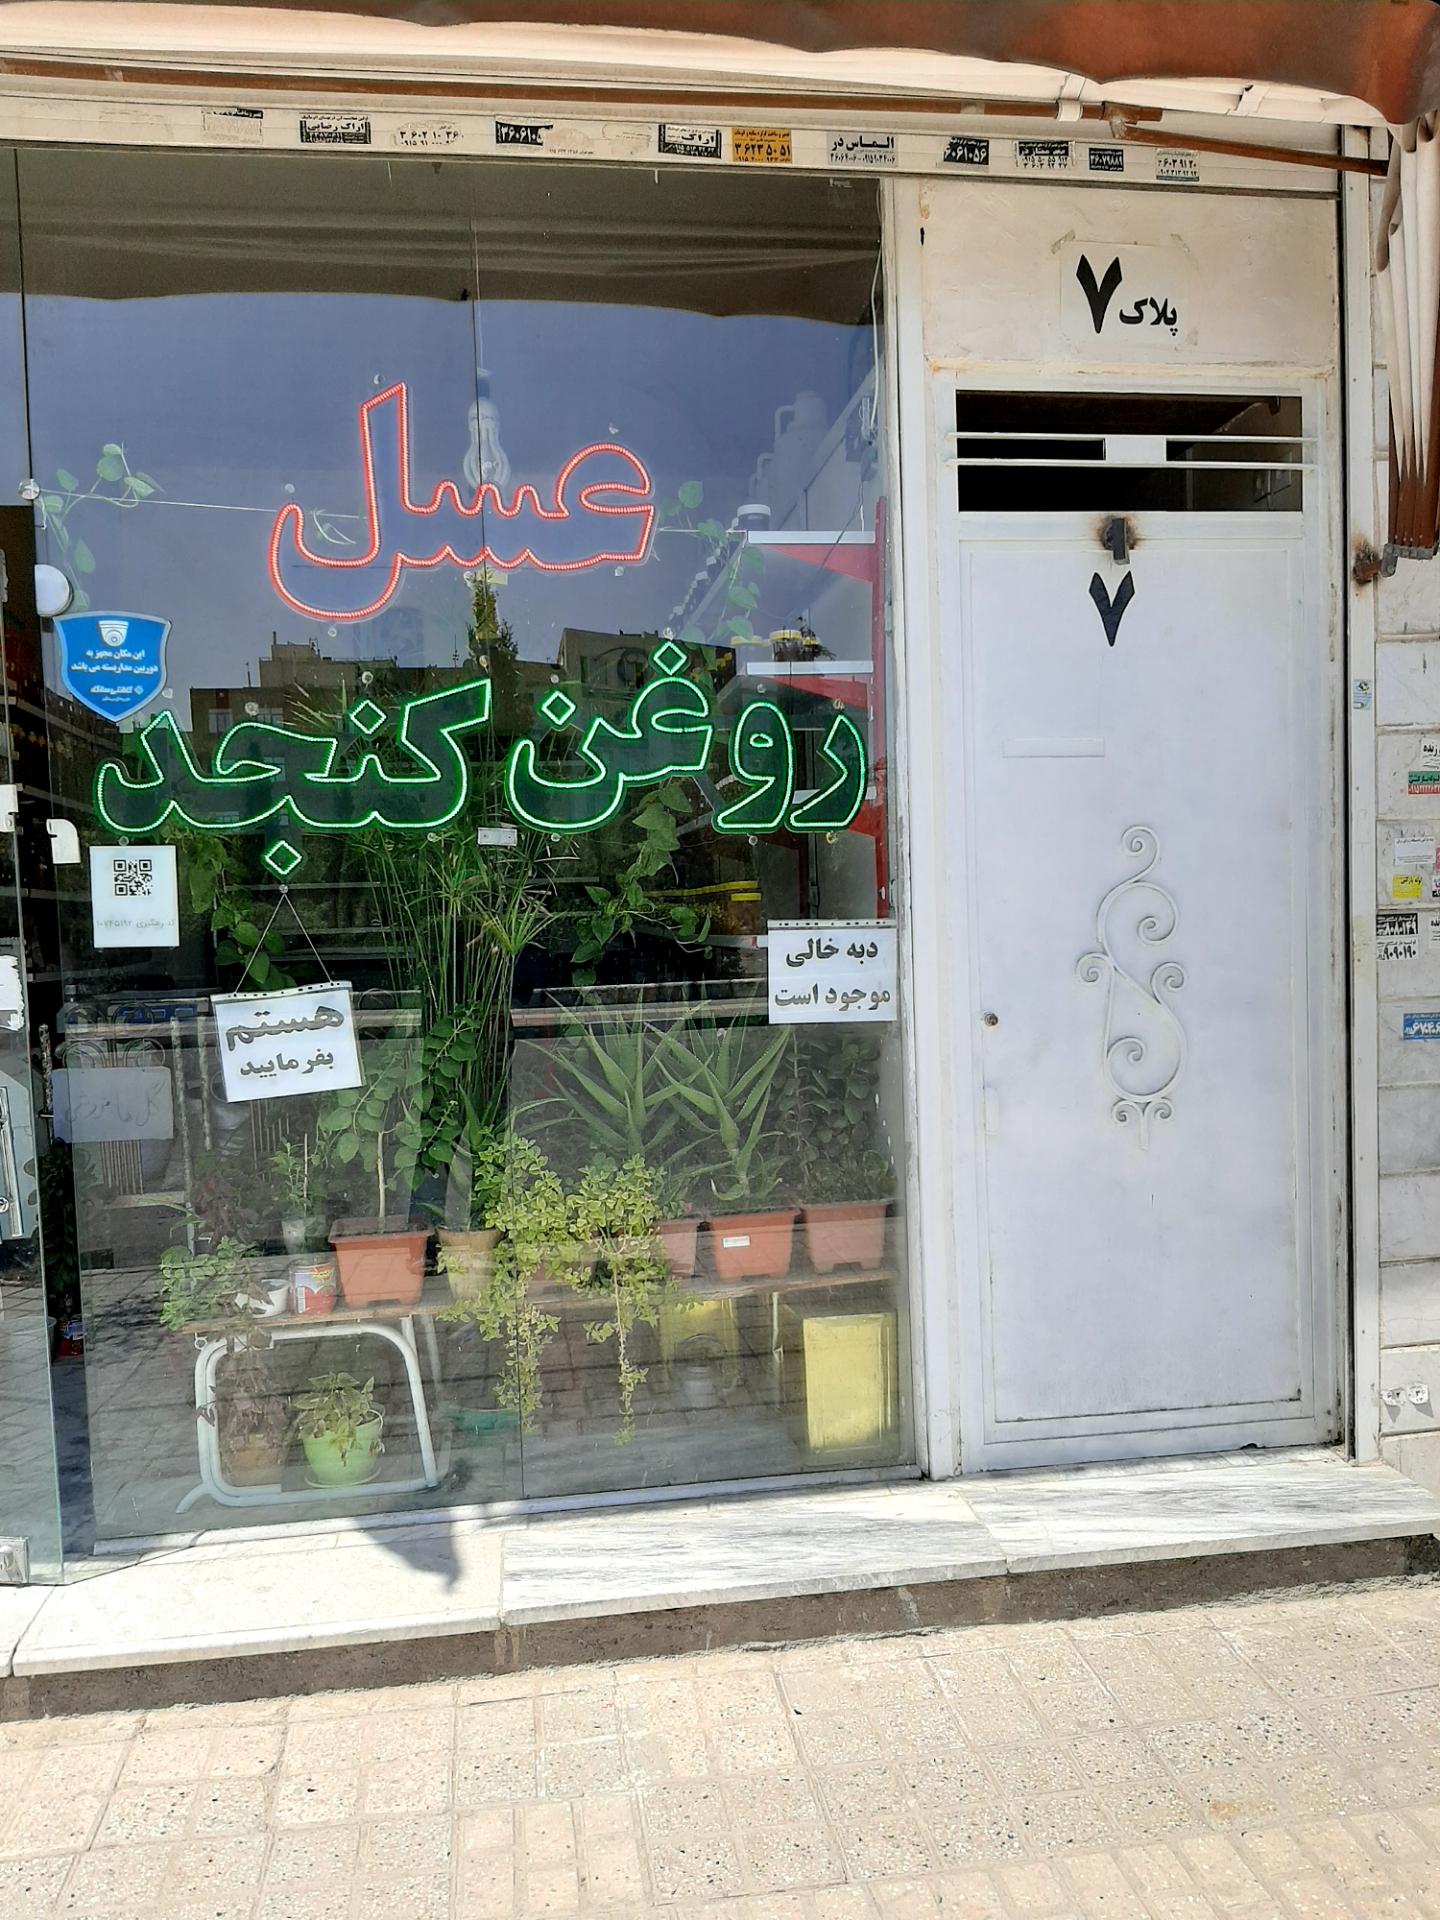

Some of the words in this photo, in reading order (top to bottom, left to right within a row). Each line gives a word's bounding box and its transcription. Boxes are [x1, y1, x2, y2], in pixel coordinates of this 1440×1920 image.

[341, 121, 364, 132] اراک
[682, 133, 715, 145] اراک
[846, 135, 895, 151] الماس
[1076, 254, 1123, 334] ۷
[1119, 296, 1178, 337] پلاک
[267, 382, 657, 622] عسل
[1088, 569, 1136, 647] ۷
[85, 650, 95, 659] به
[95, 650, 113, 660] مجهز
[112, 649, 132, 660] مکان
[132, 649, 146, 660] این
[133, 665, 159, 675] دوربین
[505, 641, 867, 833] روغن
[94, 677, 492, 877] کنجد
[785, 937, 839, 968] خالی
[846, 941, 879, 965] دبه
[774, 983, 819, 1006] است
[824, 987, 891, 1012] موجود
[225, 1005, 344, 1052] هستم
[240, 1048, 334, 1079] بفرمایید
